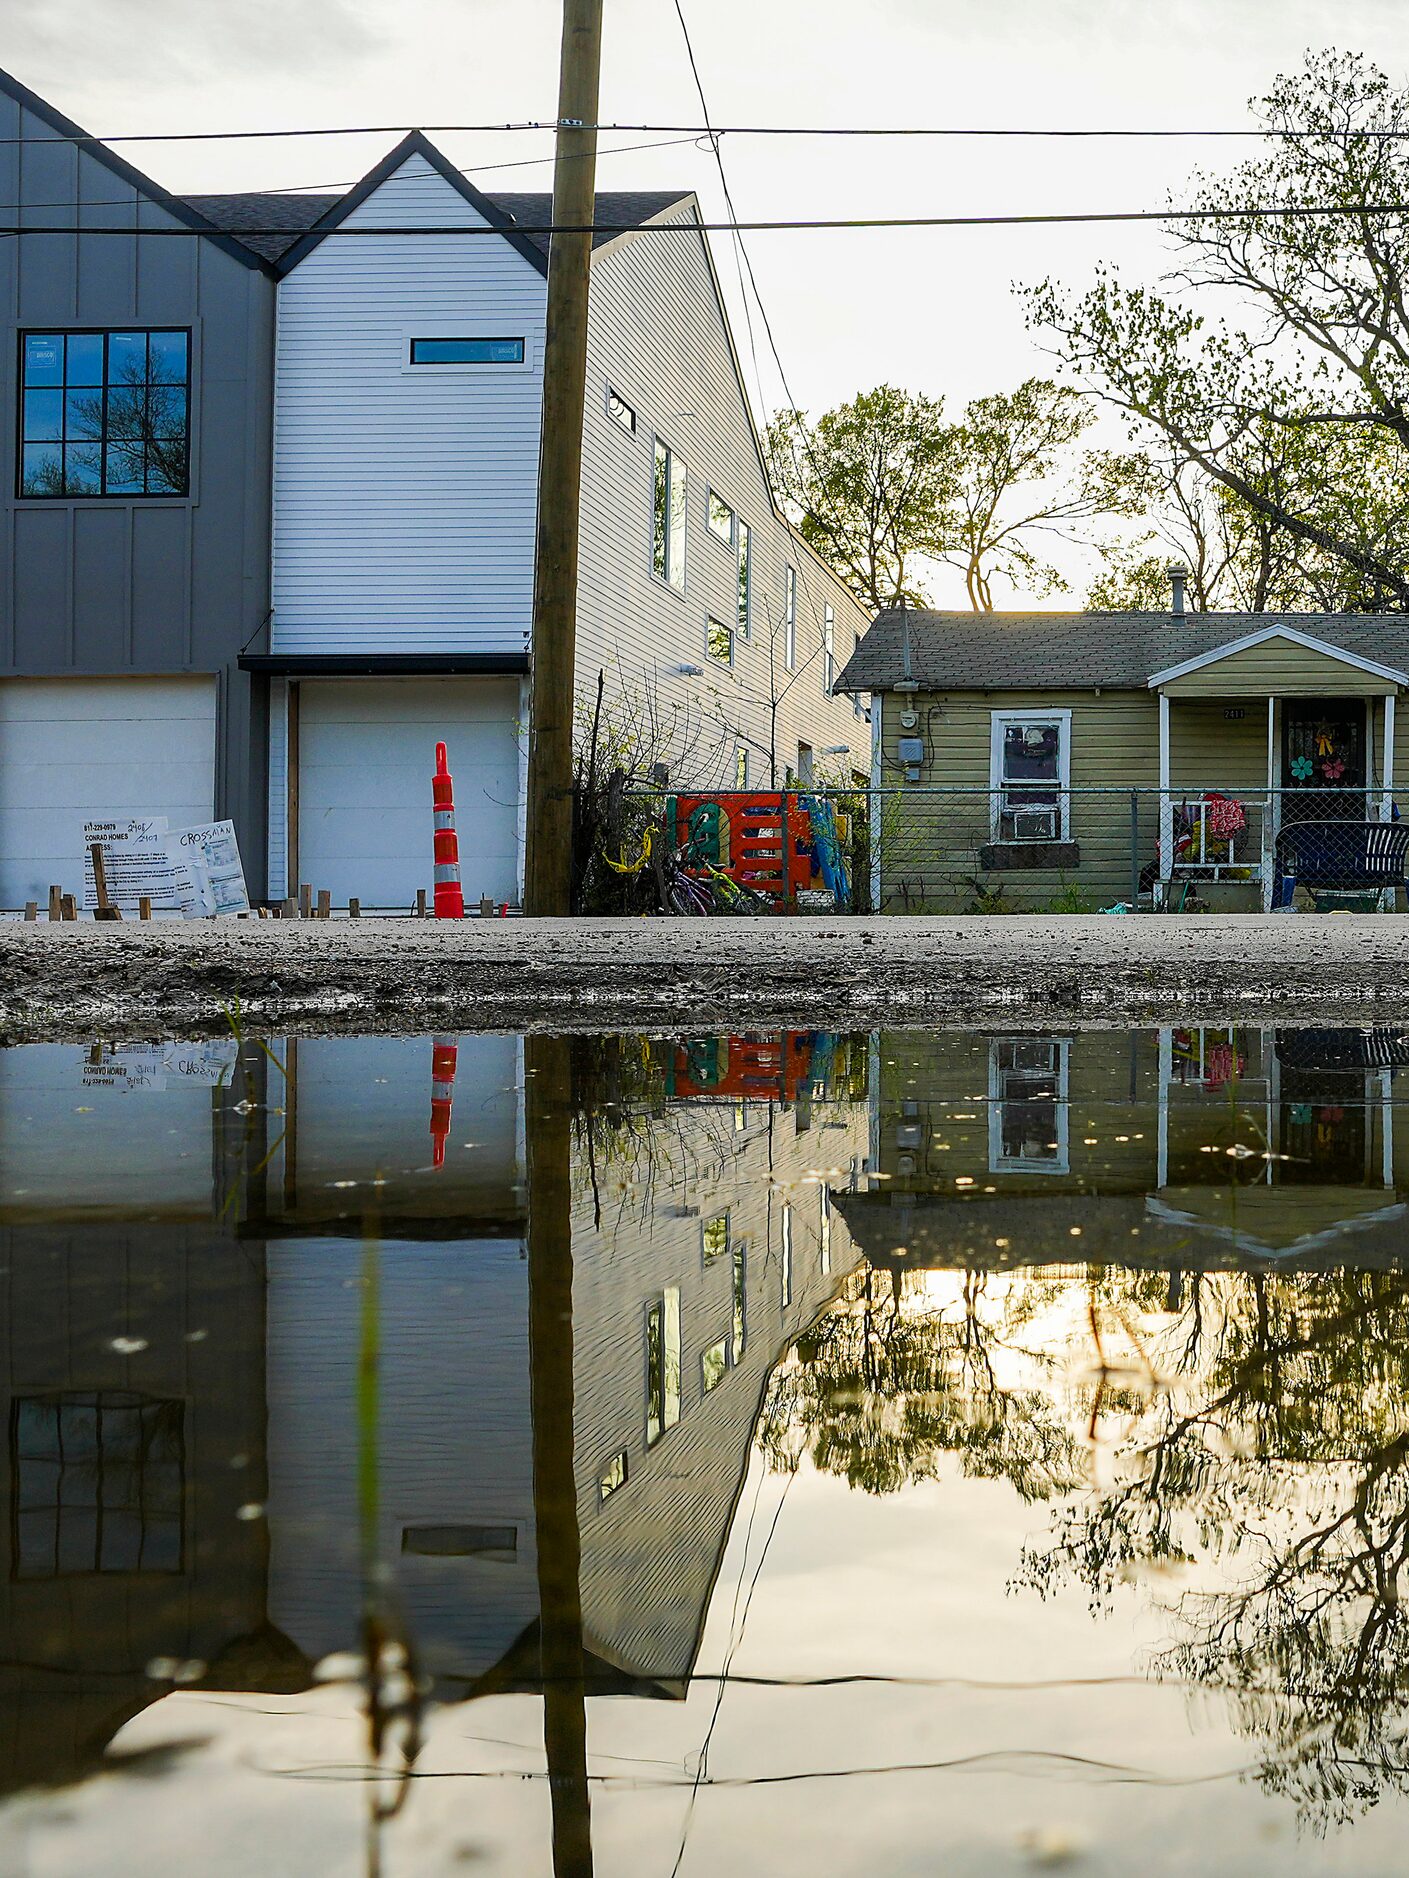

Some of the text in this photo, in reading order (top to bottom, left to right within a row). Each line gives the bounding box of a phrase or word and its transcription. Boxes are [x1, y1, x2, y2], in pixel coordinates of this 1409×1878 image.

[85, 833, 129, 842] CONRAD HOMES
[180, 827, 231, 846] CROSSMAN
[86, 844, 113, 852] AESS:
